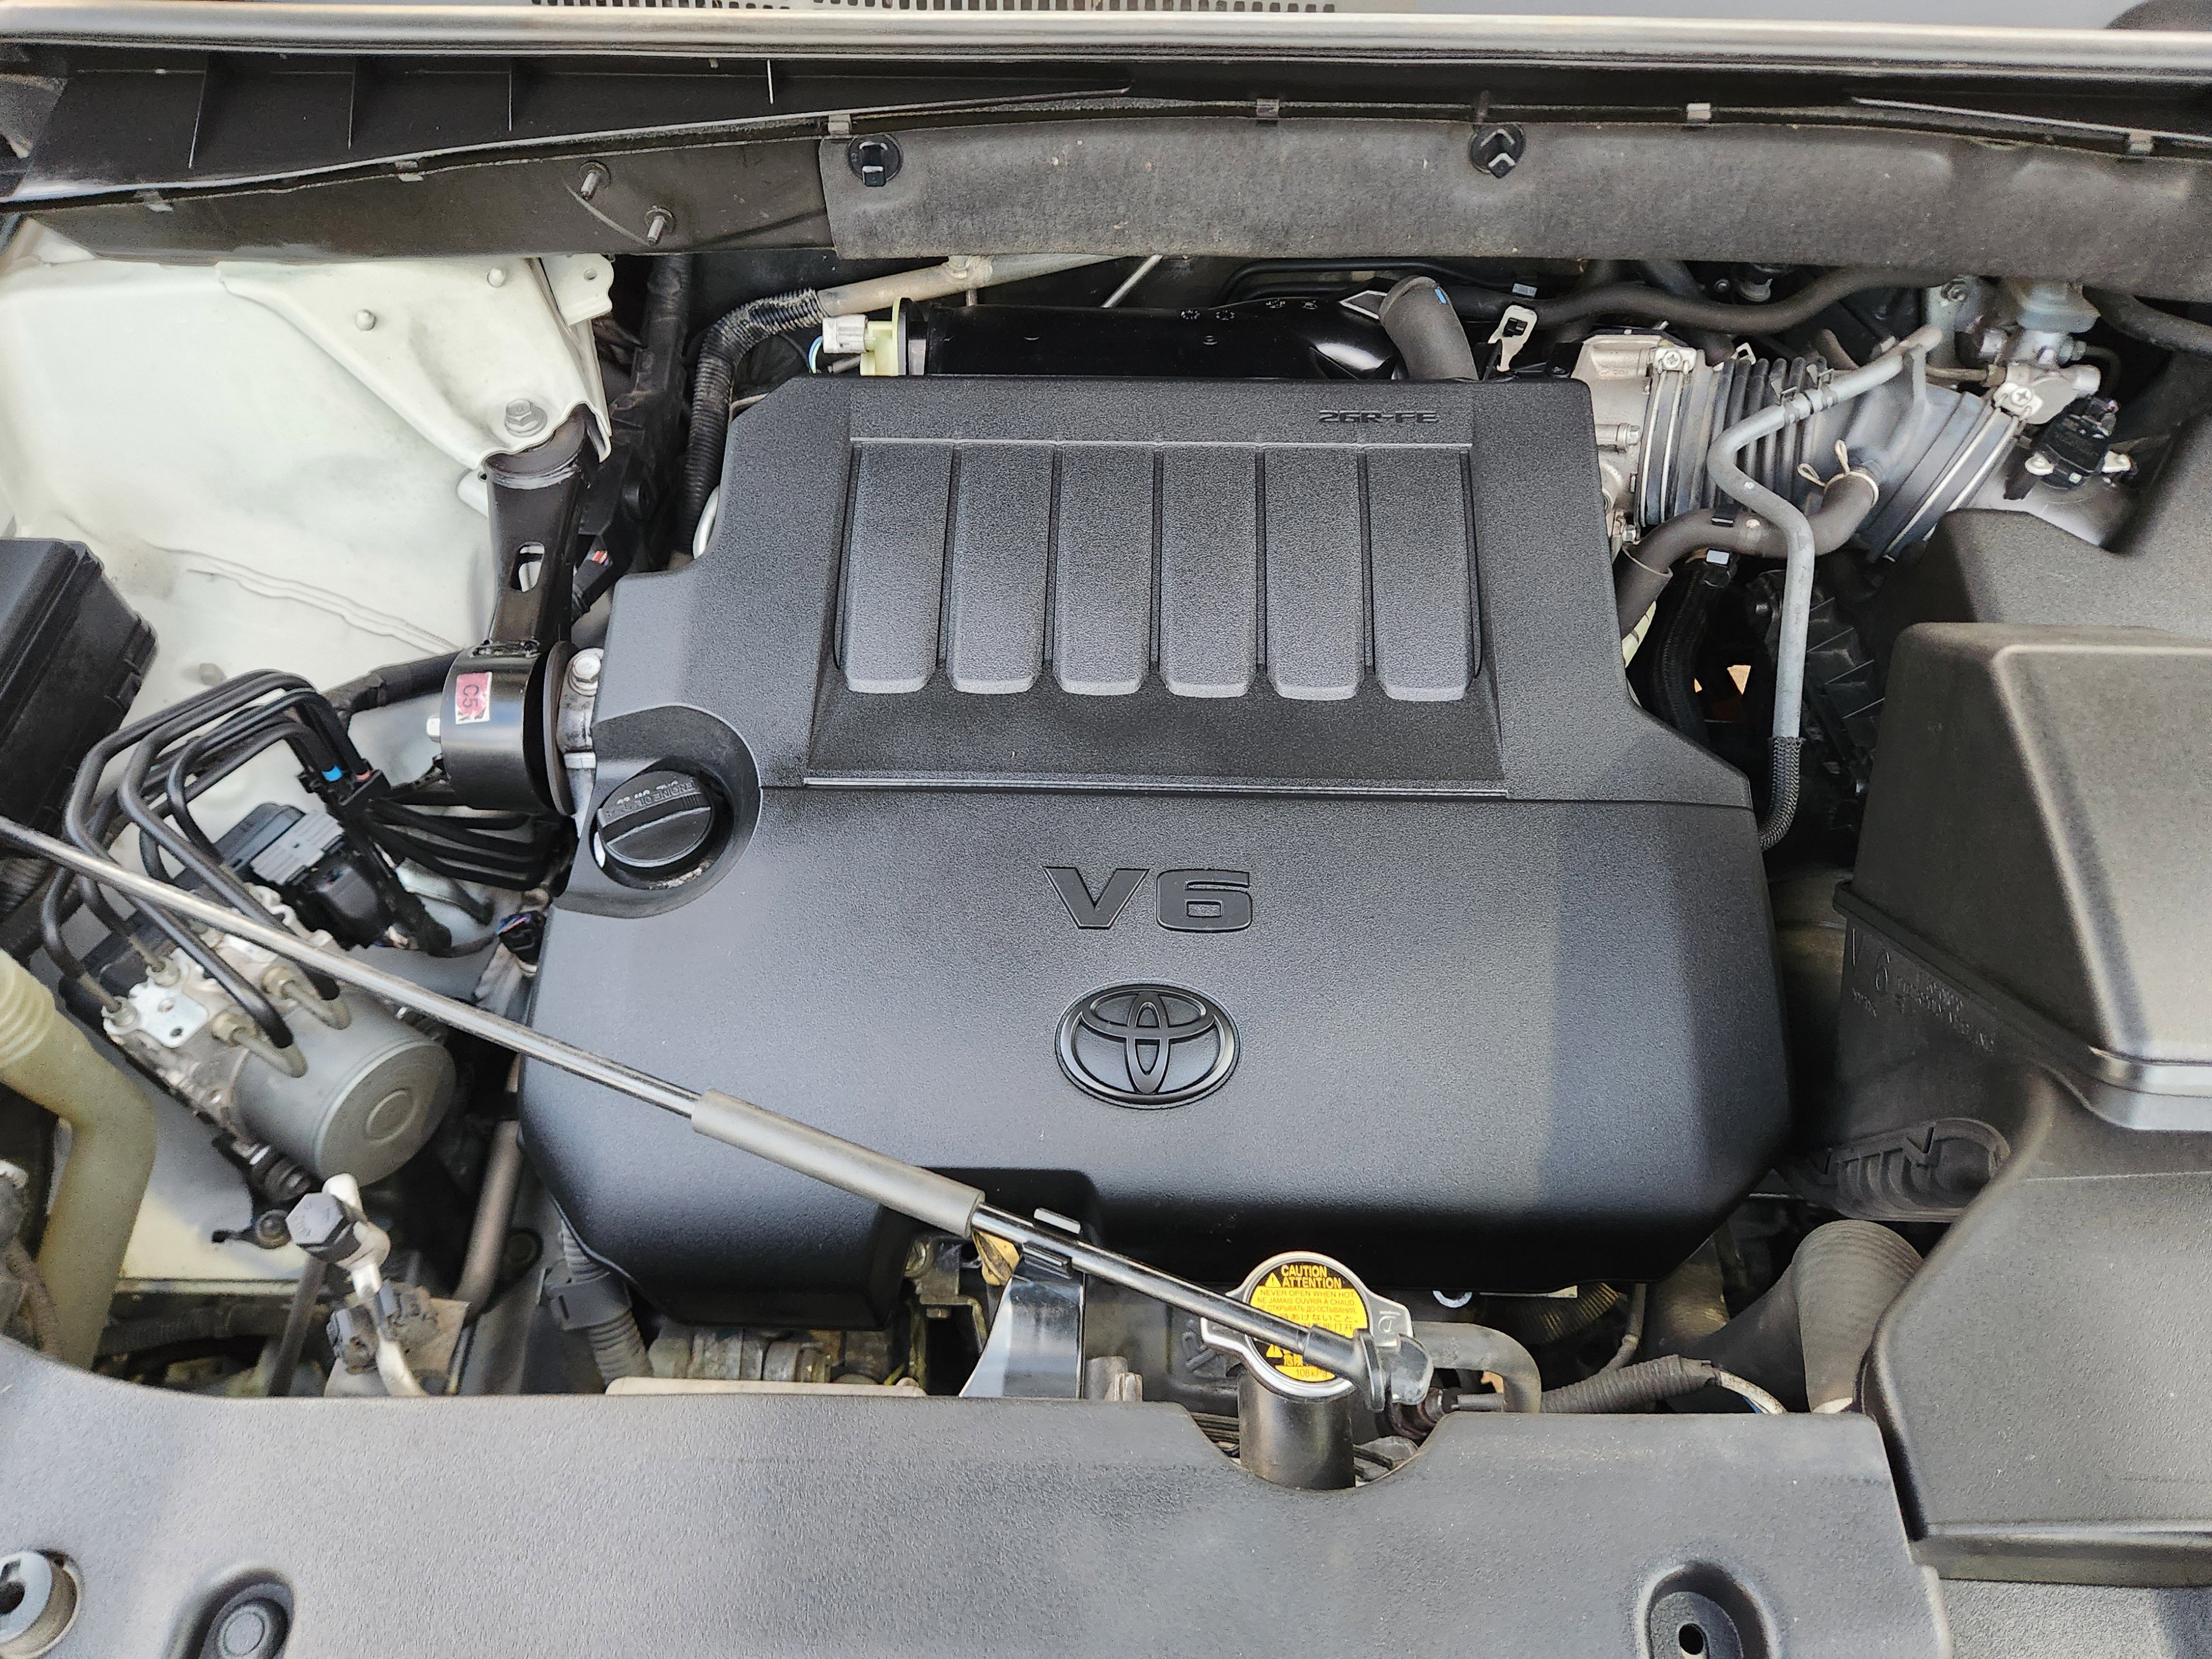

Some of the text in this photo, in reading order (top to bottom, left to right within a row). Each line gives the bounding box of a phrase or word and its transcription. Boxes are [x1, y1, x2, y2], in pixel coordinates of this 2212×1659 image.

[1318, 410, 1438, 423] 2GR-FE
[463, 684, 480, 708] C5
[653, 779, 695, 802] ENGINE
[1042, 865, 1254, 933] V6
[1281, 1264, 1327, 1278] CAUTION
[1282, 1276, 1342, 1289] ATTENTION
